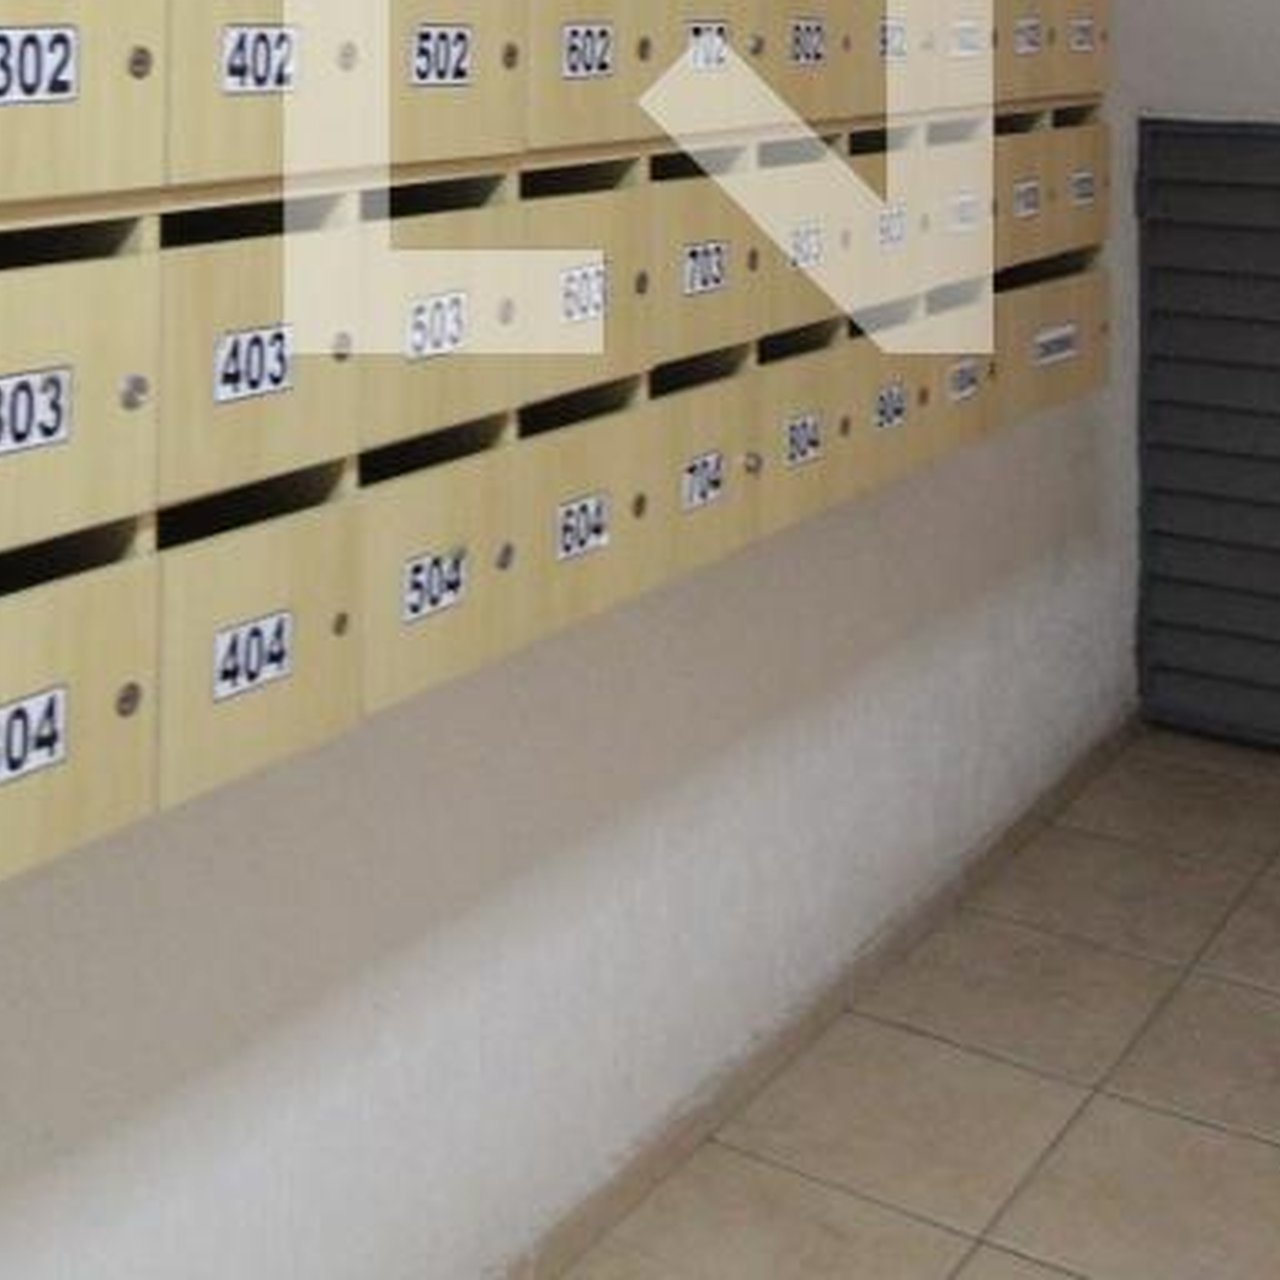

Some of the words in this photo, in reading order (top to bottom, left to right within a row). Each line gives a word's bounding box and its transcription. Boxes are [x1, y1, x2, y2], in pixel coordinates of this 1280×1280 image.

[227, 33, 293, 86] 402
[415, 32, 468, 80] 502
[565, 29, 610, 72] 602
[411, 295, 464, 352] 503
[220, 332, 288, 391] 403
[561, 501, 605, 552] 604
[408, 554, 463, 613] 504
[220, 618, 286, 686] 404
